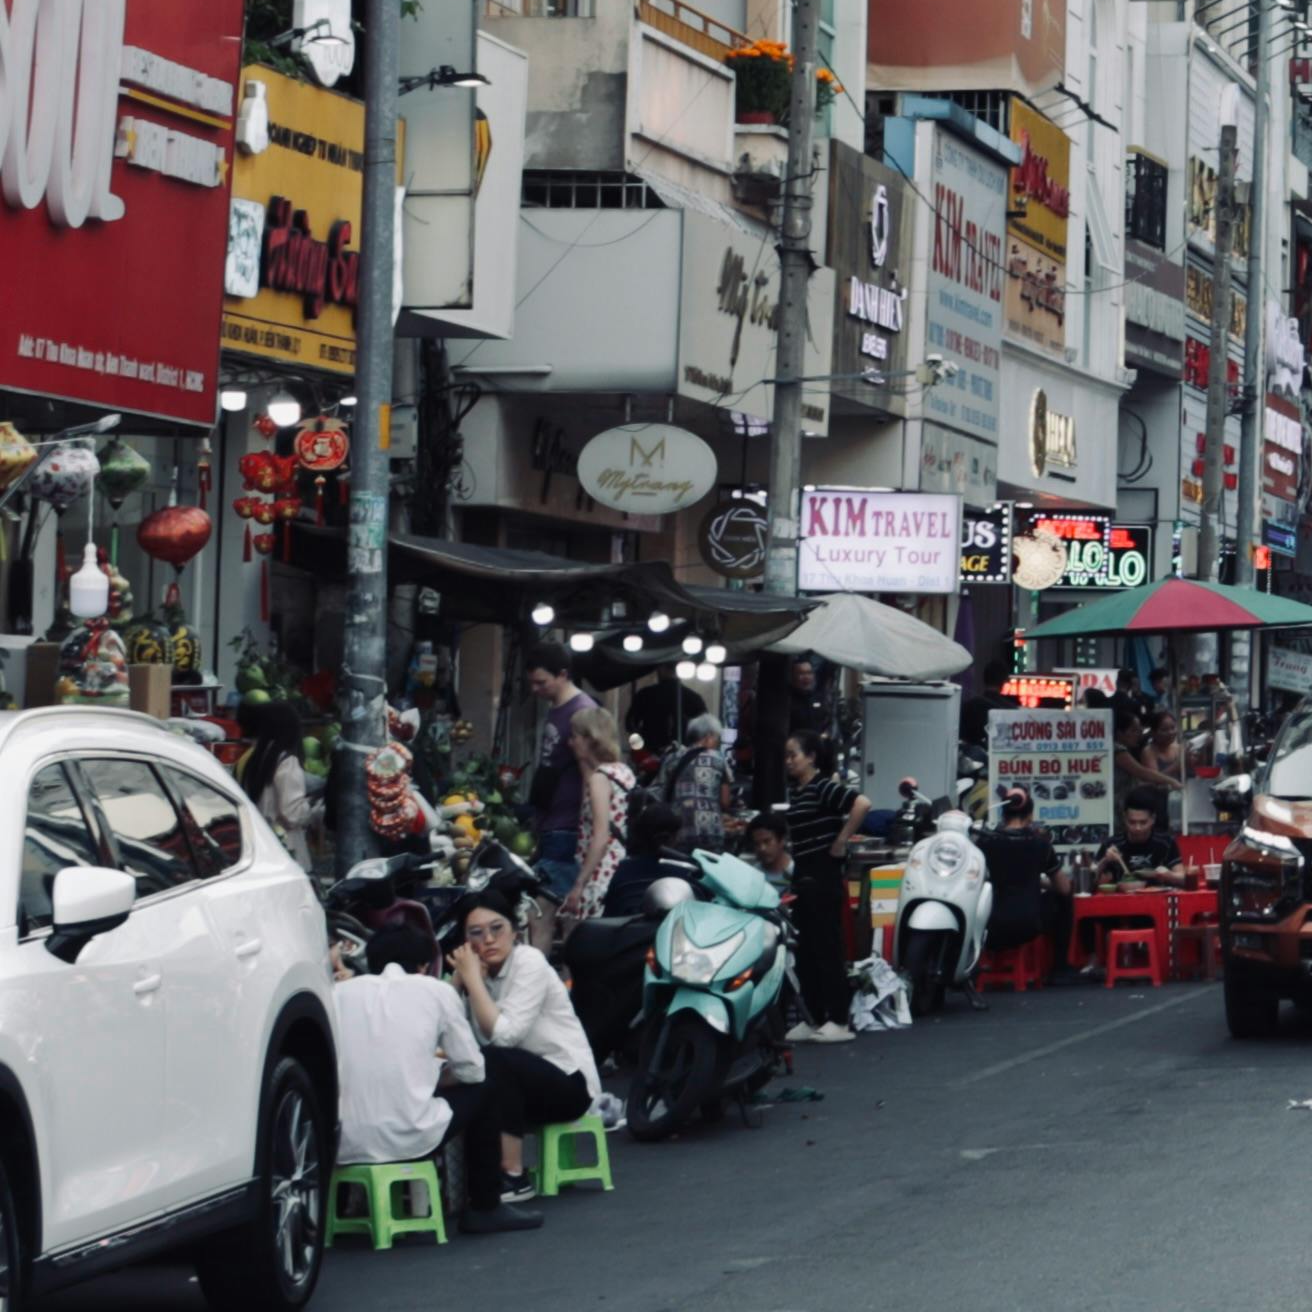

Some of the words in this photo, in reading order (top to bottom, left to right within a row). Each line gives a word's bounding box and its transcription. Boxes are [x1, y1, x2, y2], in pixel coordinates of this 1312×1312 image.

[933, 181, 964, 284] KIM
[809, 496, 869, 538] KIM
[872, 510, 952, 540] TRAVEL
[815, 544, 887, 569] Luxury
[894, 545, 942, 566] Tour
[998, 755, 1033, 775] BÚN
[1039, 754, 1062, 774] BÒ
[1068, 754, 1108, 775] HUẾ
